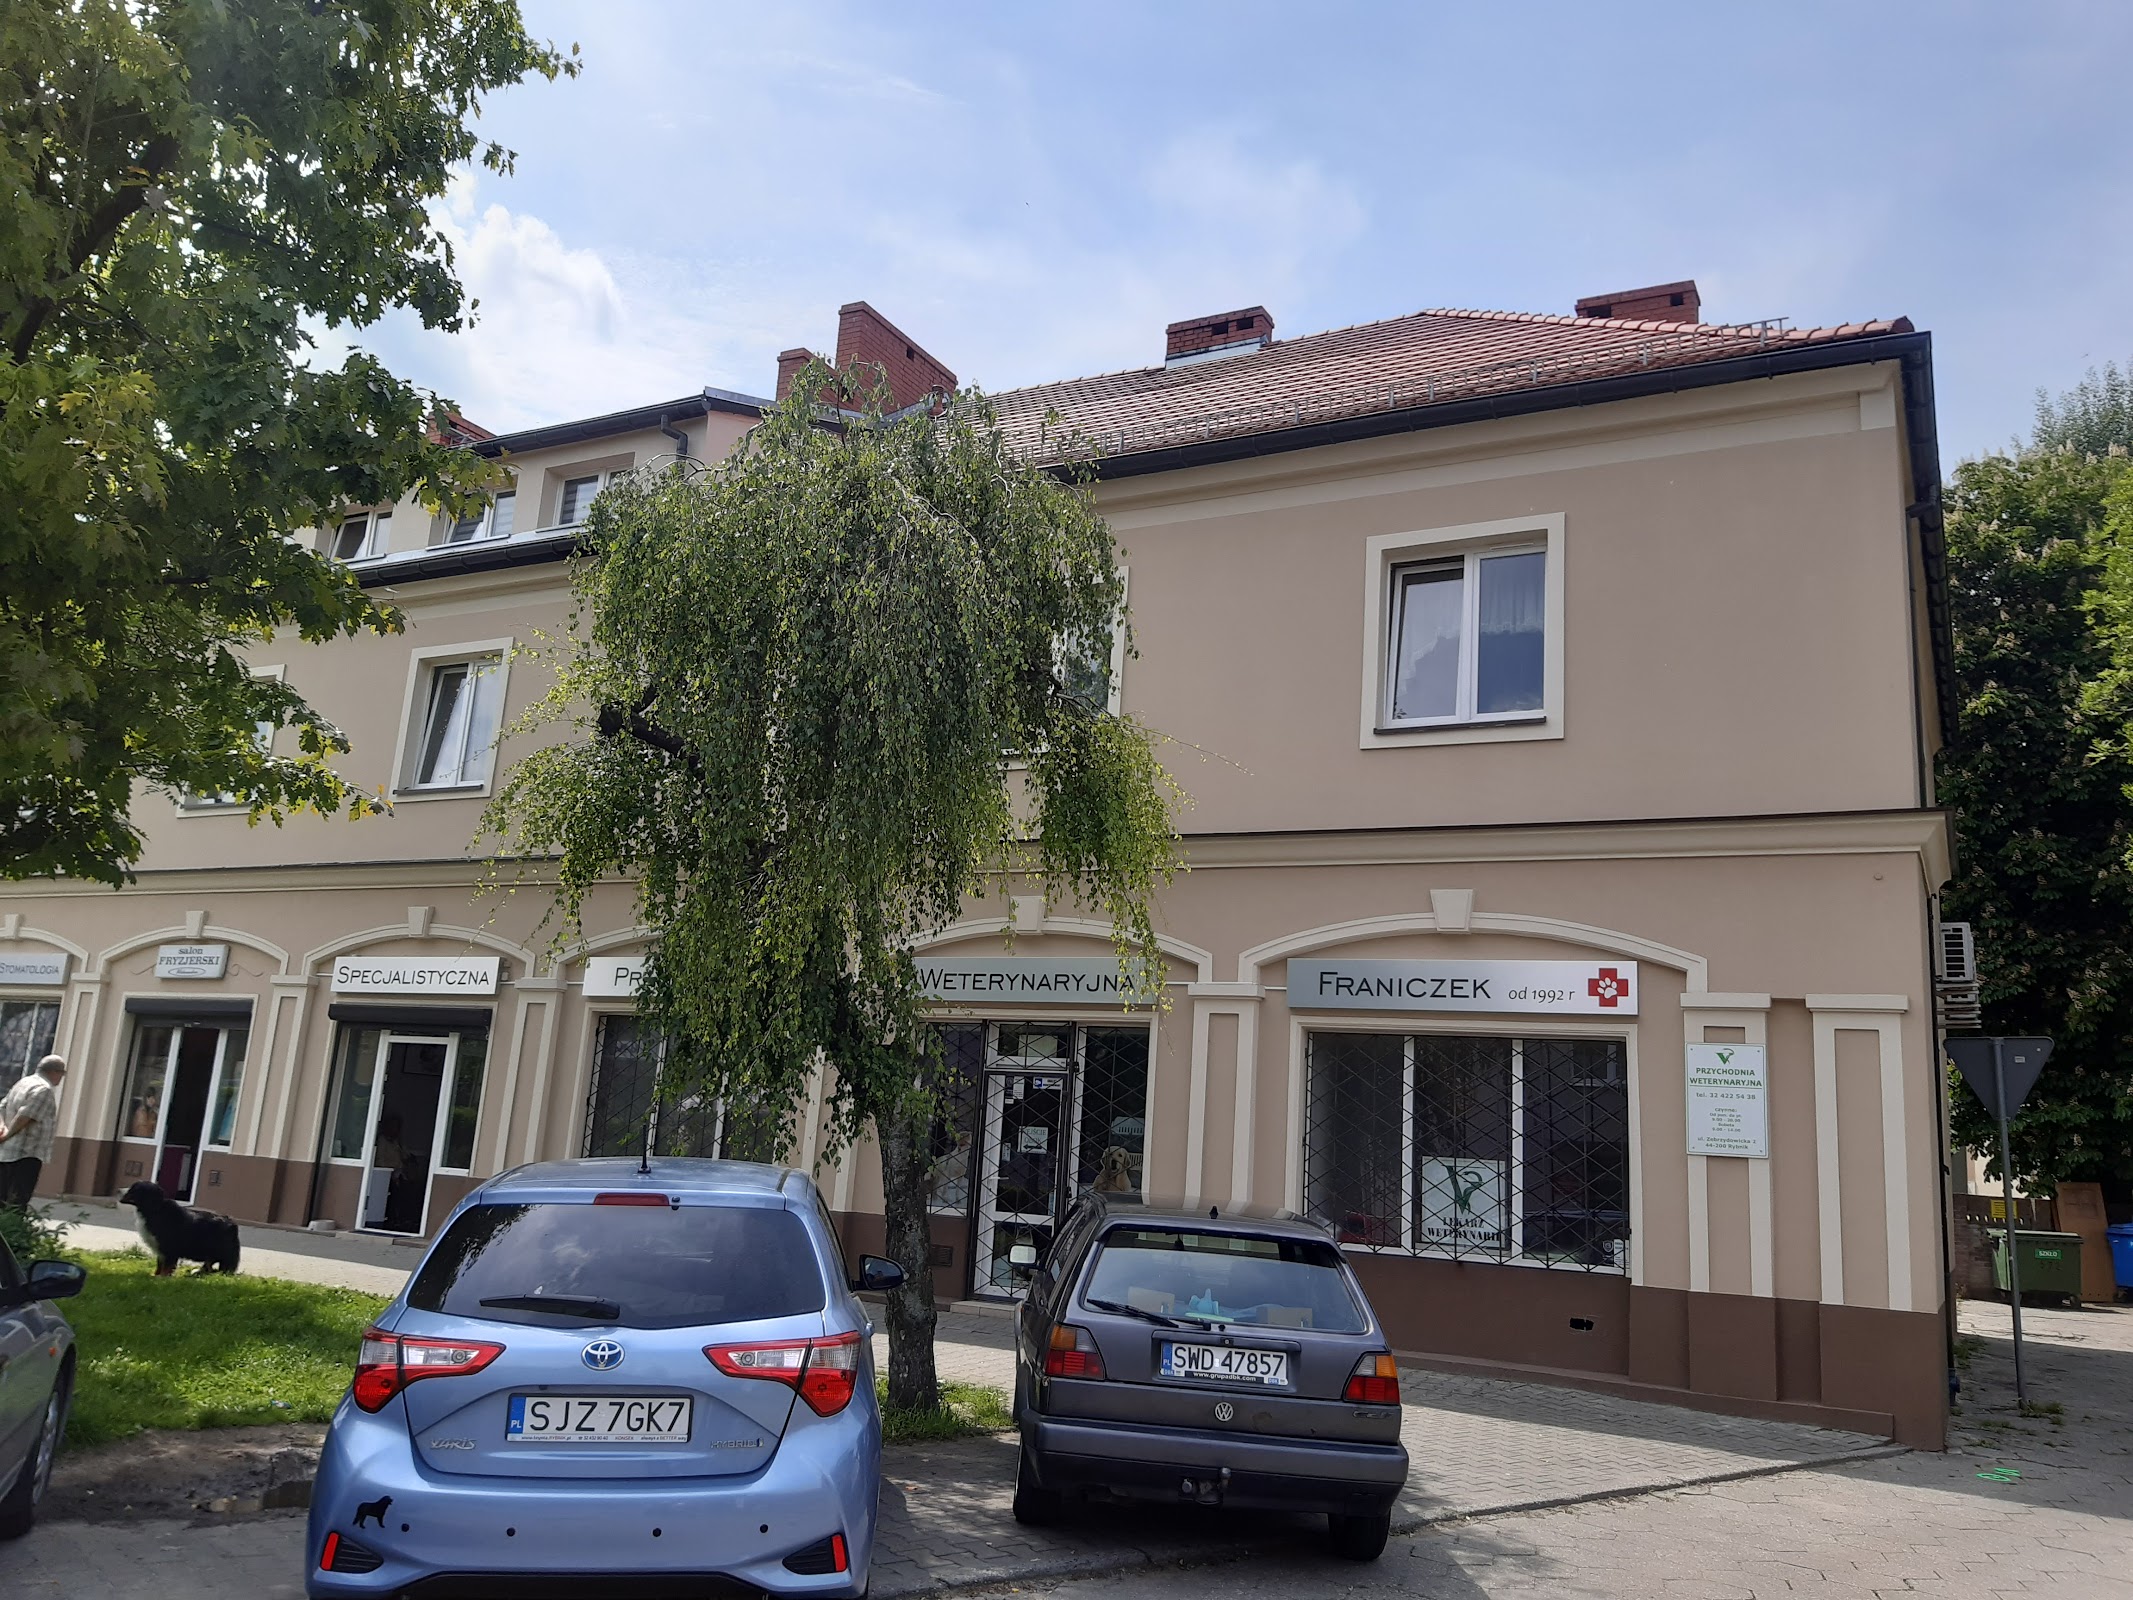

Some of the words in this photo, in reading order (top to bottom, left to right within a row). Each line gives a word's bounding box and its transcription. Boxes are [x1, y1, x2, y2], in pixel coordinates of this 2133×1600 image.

[178, 947, 204, 955] salon
[159, 956, 221, 965] FRYZJERSKI
[337, 966, 490, 986] SPECJALISTYCZNA
[920, 968, 1135, 992] WETERYNARYJNA
[1319, 971, 1491, 999] FRANICZEK
[1508, 986, 1527, 1000] od
[1531, 988, 1564, 1004] 1992
[1568, 990, 1575, 1001] r
[1696, 1067, 1755, 1076] PRZYCHODNIA
[1689, 1077, 1763, 1087] WETERYNARYJNA
[1163, 1358, 1171, 1366] PL
[1174, 1346, 1214, 1371] SWD
[1220, 1350, 1284, 1377] 47857
[1193, 1371, 1257, 1382] www.grupadbk.com
[510, 1419, 522, 1429] PL
[529, 1401, 598, 1432] SJZ
[607, 1401, 685, 1432] 7GK7
